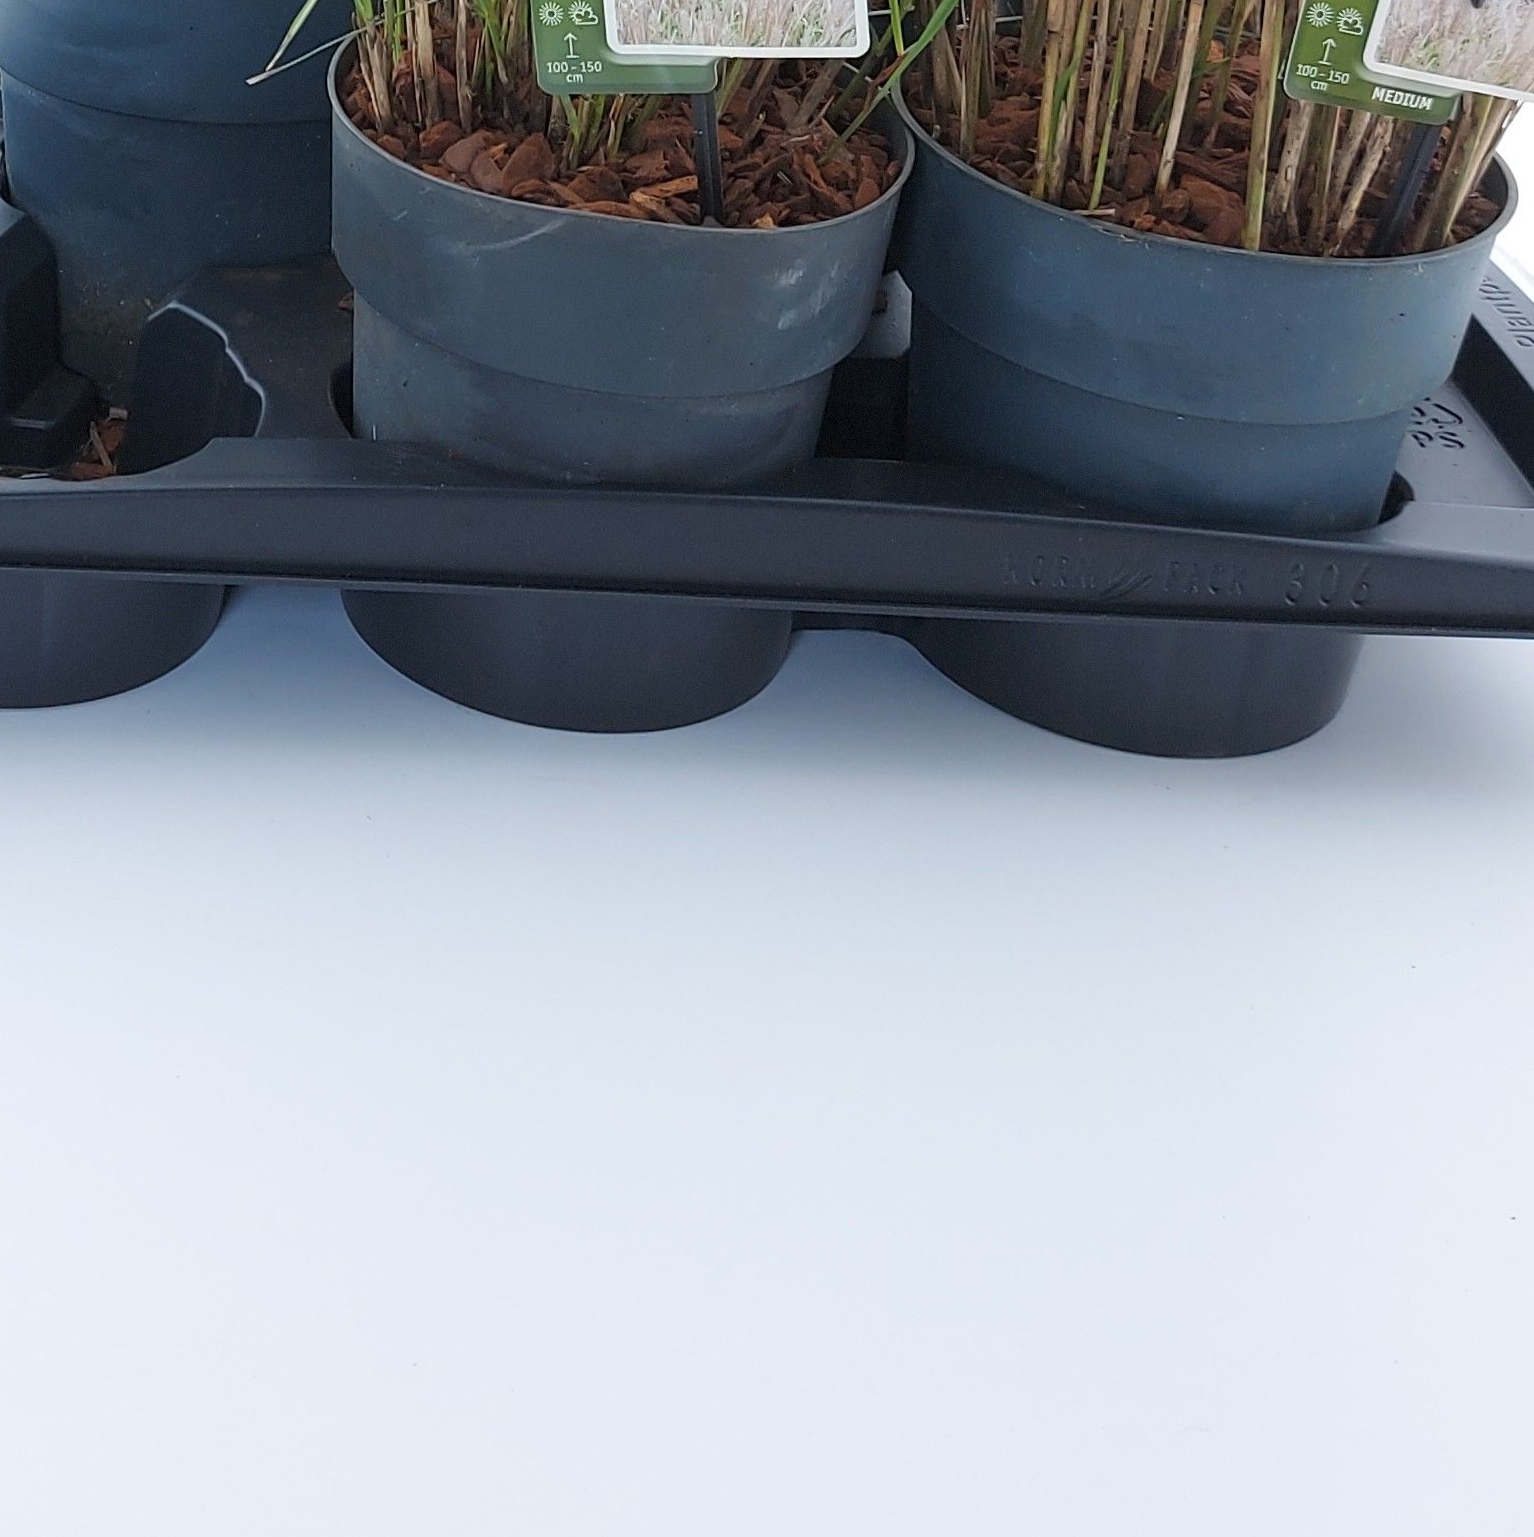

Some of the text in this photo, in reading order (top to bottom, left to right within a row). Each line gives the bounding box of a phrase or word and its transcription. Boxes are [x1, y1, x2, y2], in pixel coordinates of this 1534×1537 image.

[546, 61, 569, 73] 100
[580, 61, 602, 73] 150
[566, 73, 584, 83] cm
[1295, 63, 1318, 78] 100
[1327, 69, 1350, 85] 150
[1310, 80, 1328, 91] cm
[1371, 86, 1434, 111] MEDIUM
